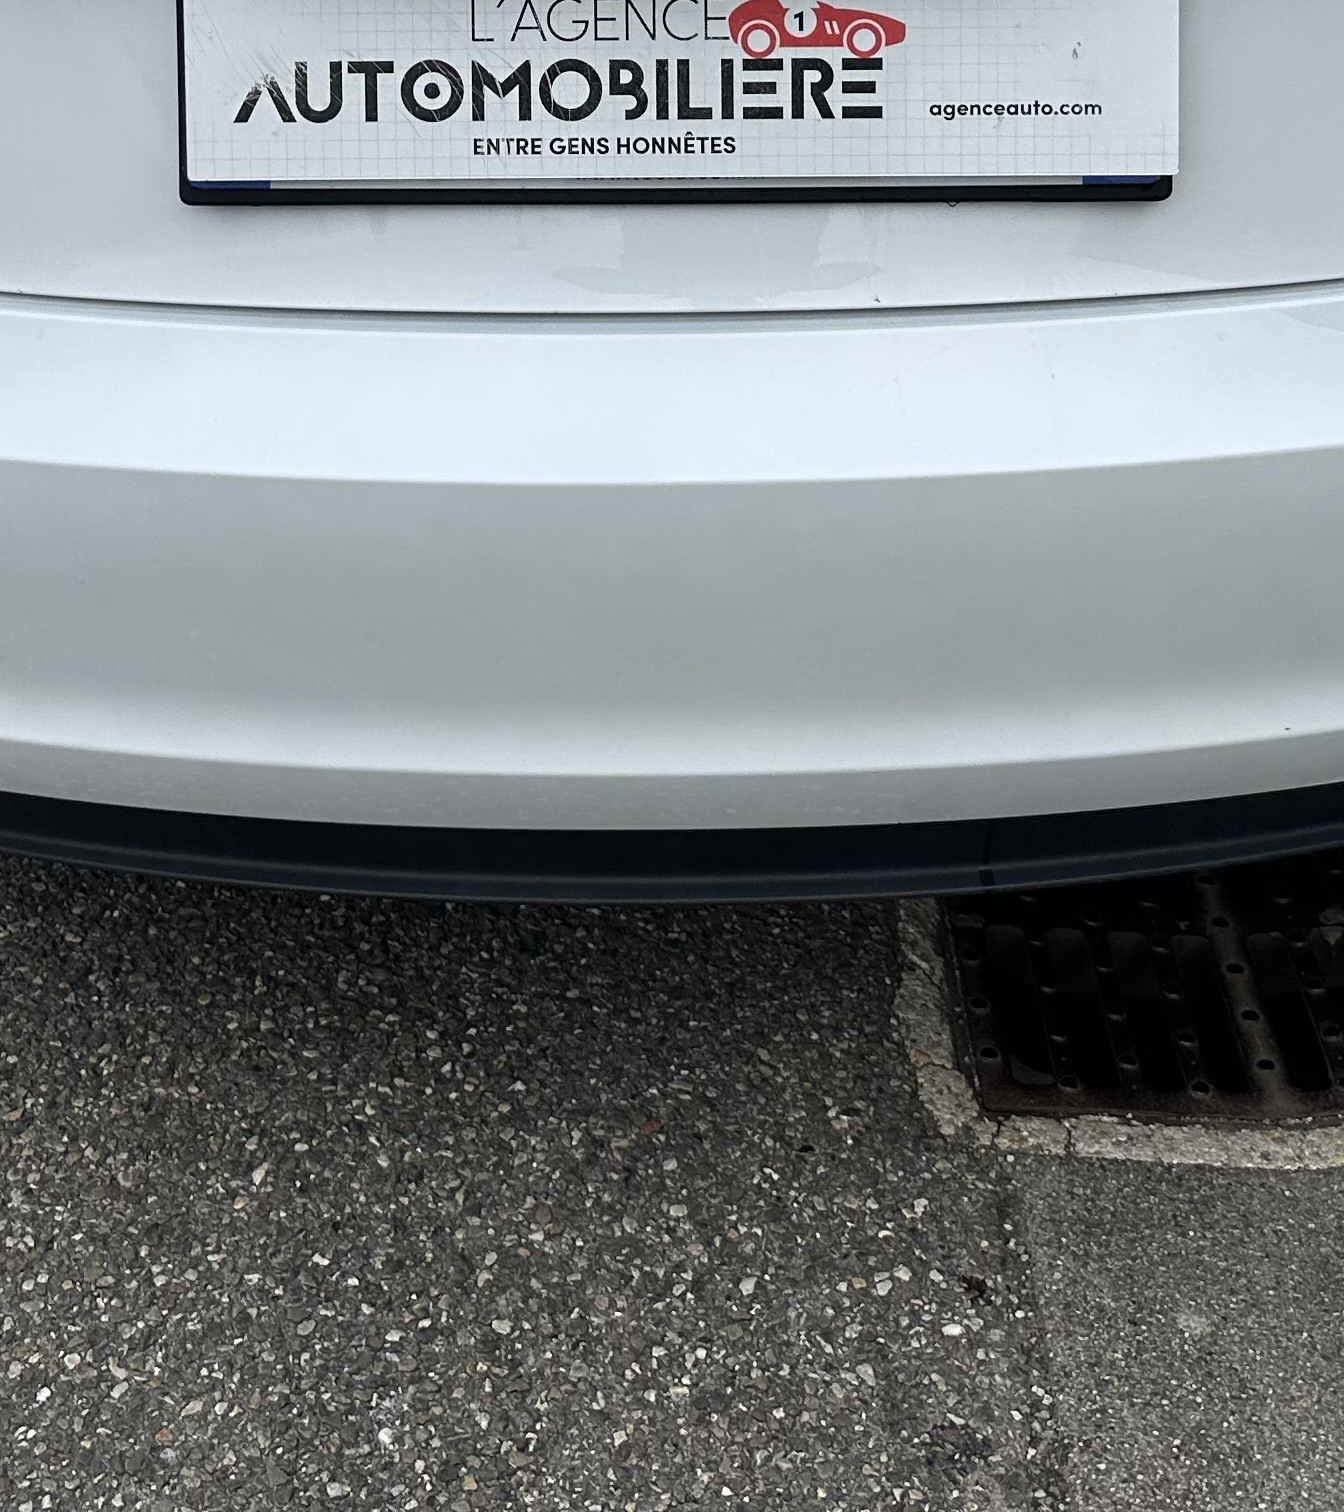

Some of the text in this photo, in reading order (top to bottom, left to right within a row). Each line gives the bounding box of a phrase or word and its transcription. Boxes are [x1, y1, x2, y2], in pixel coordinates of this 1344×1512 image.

[793, 11, 805, 32] 1
[929, 100, 1103, 120] agenceauto.com
[473, 130, 736, 155] ENTRE GENS HONNÊTES
